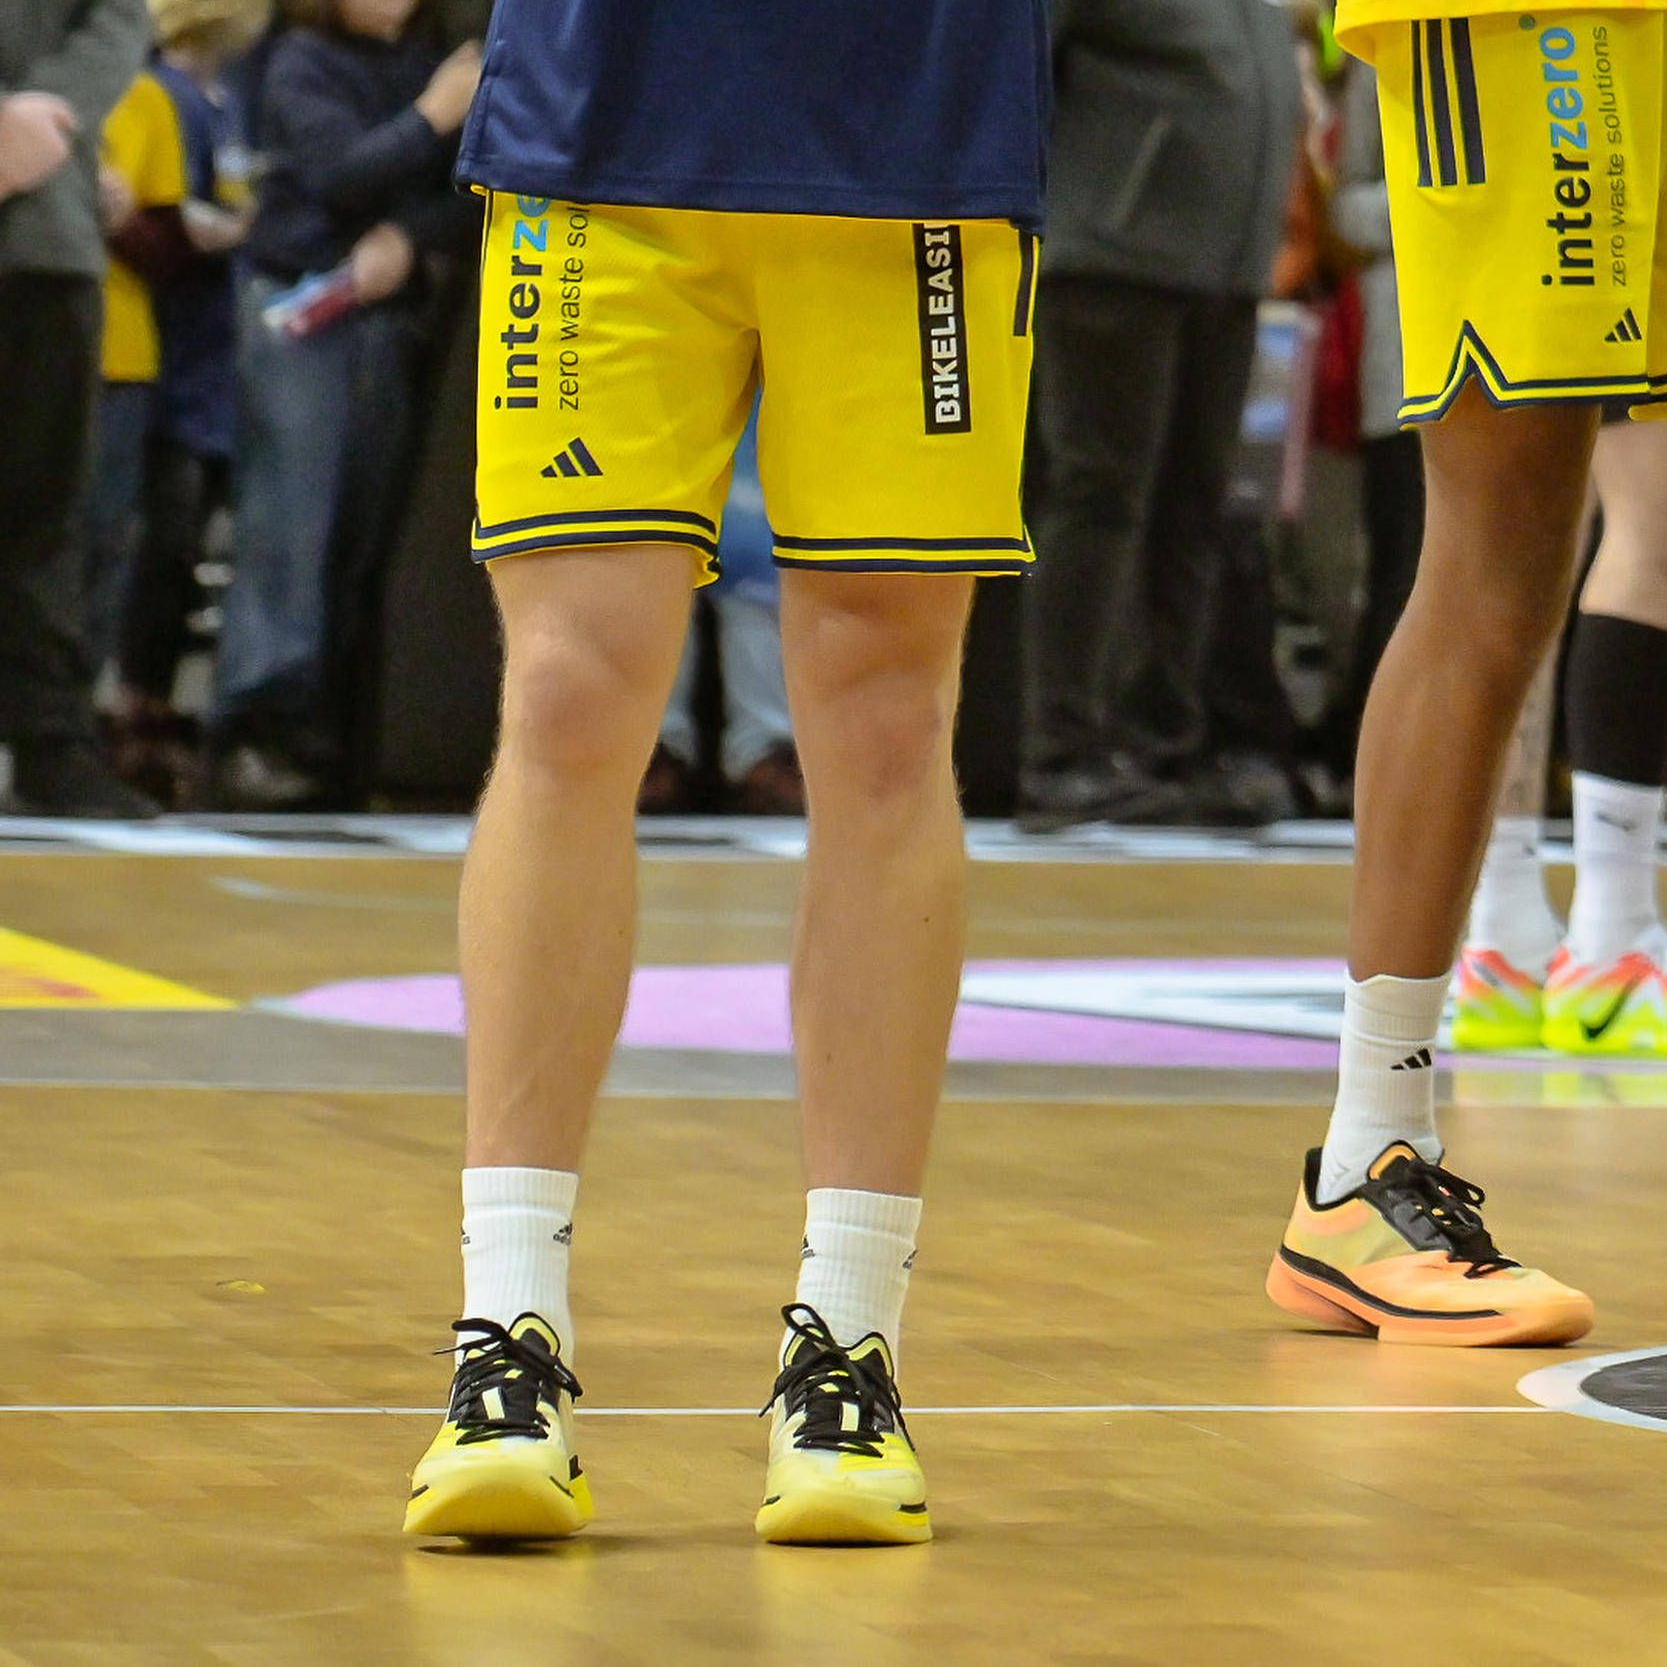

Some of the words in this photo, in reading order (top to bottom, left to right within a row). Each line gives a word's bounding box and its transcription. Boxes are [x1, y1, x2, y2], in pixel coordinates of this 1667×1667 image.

[1592, 25, 1623, 146] solutions
[1538, 27, 1595, 287] interzero
[1604, 152, 1626, 229] waste
[559, 257, 586, 343] waste
[1611, 235, 1627, 288] zero
[557, 349, 581, 412] zero
